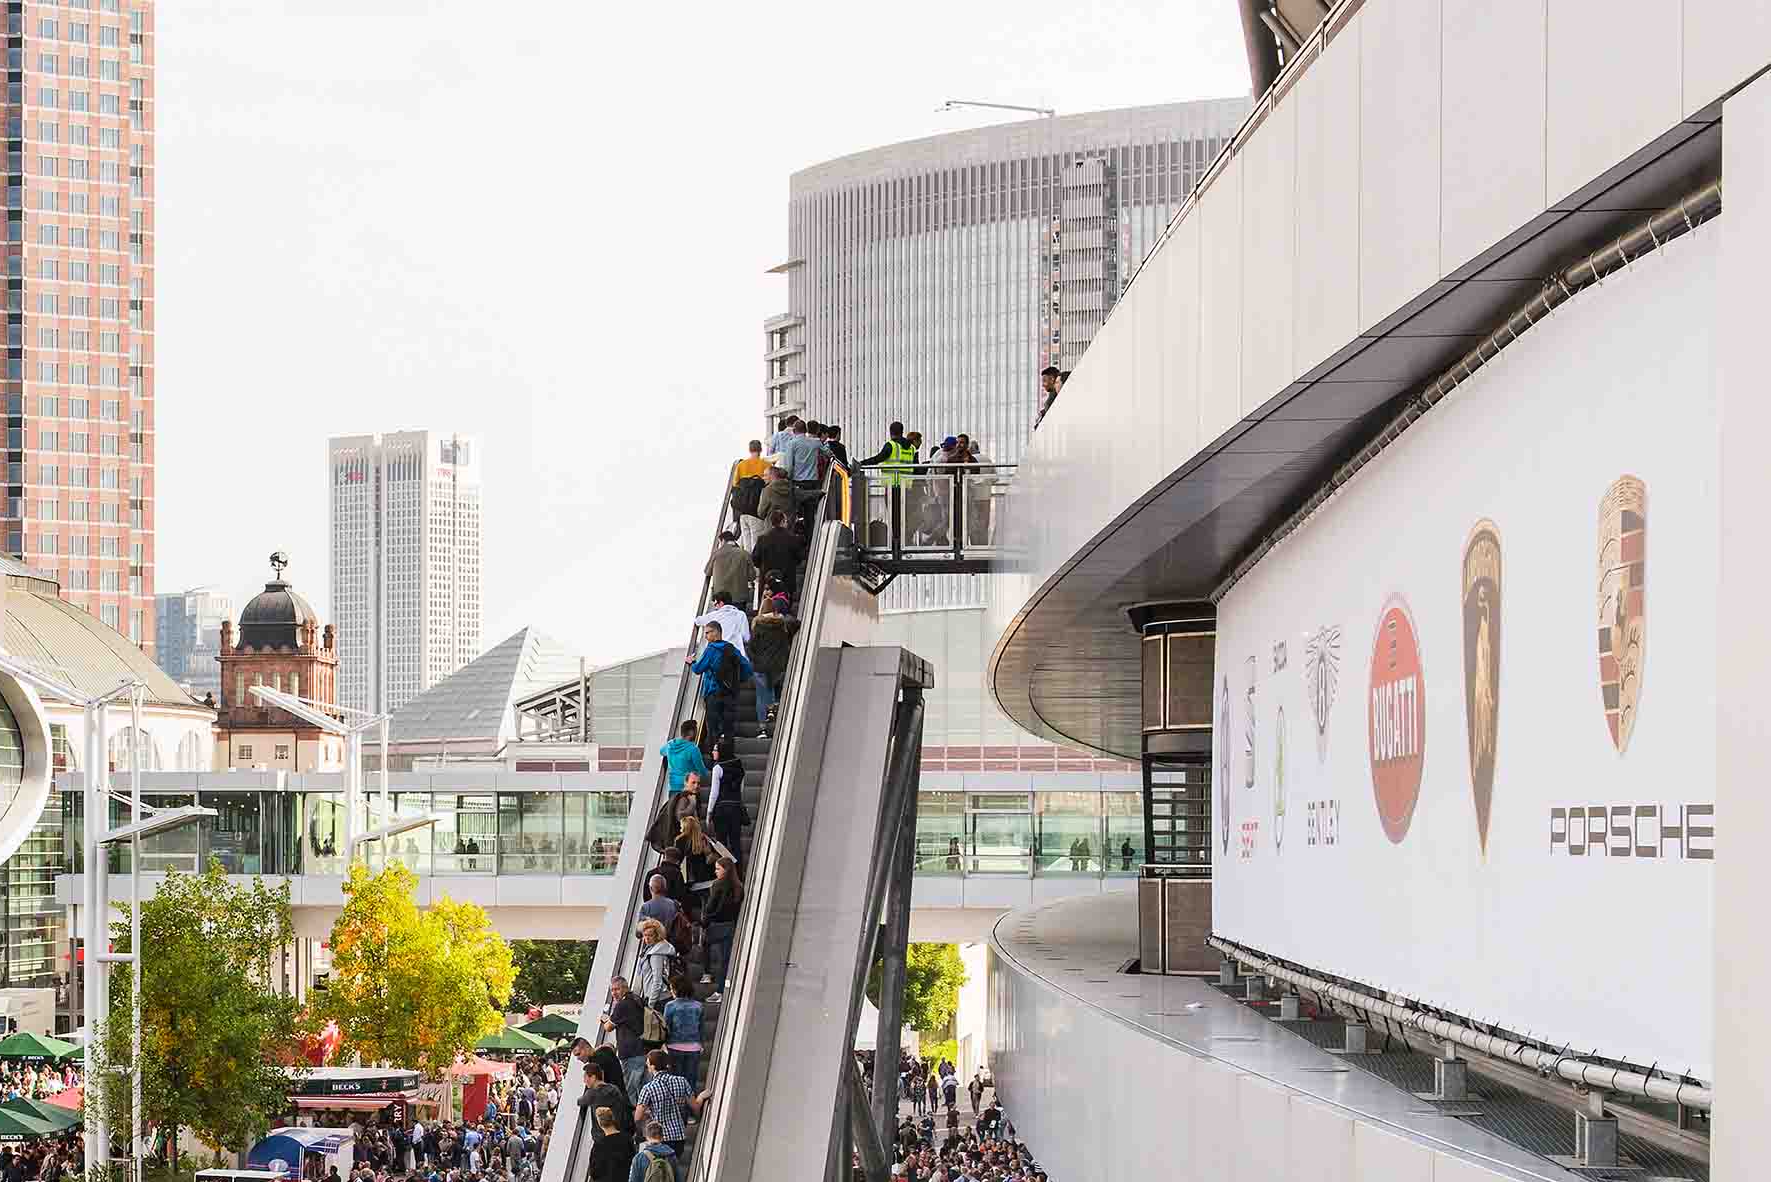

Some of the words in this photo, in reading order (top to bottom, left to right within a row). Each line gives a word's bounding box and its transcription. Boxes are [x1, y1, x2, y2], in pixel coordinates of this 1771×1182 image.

[1372, 673, 1418, 761] BUGATTI
[1550, 803, 1715, 859] PORSCHE
[332, 1082, 361, 1091] BECK'S
